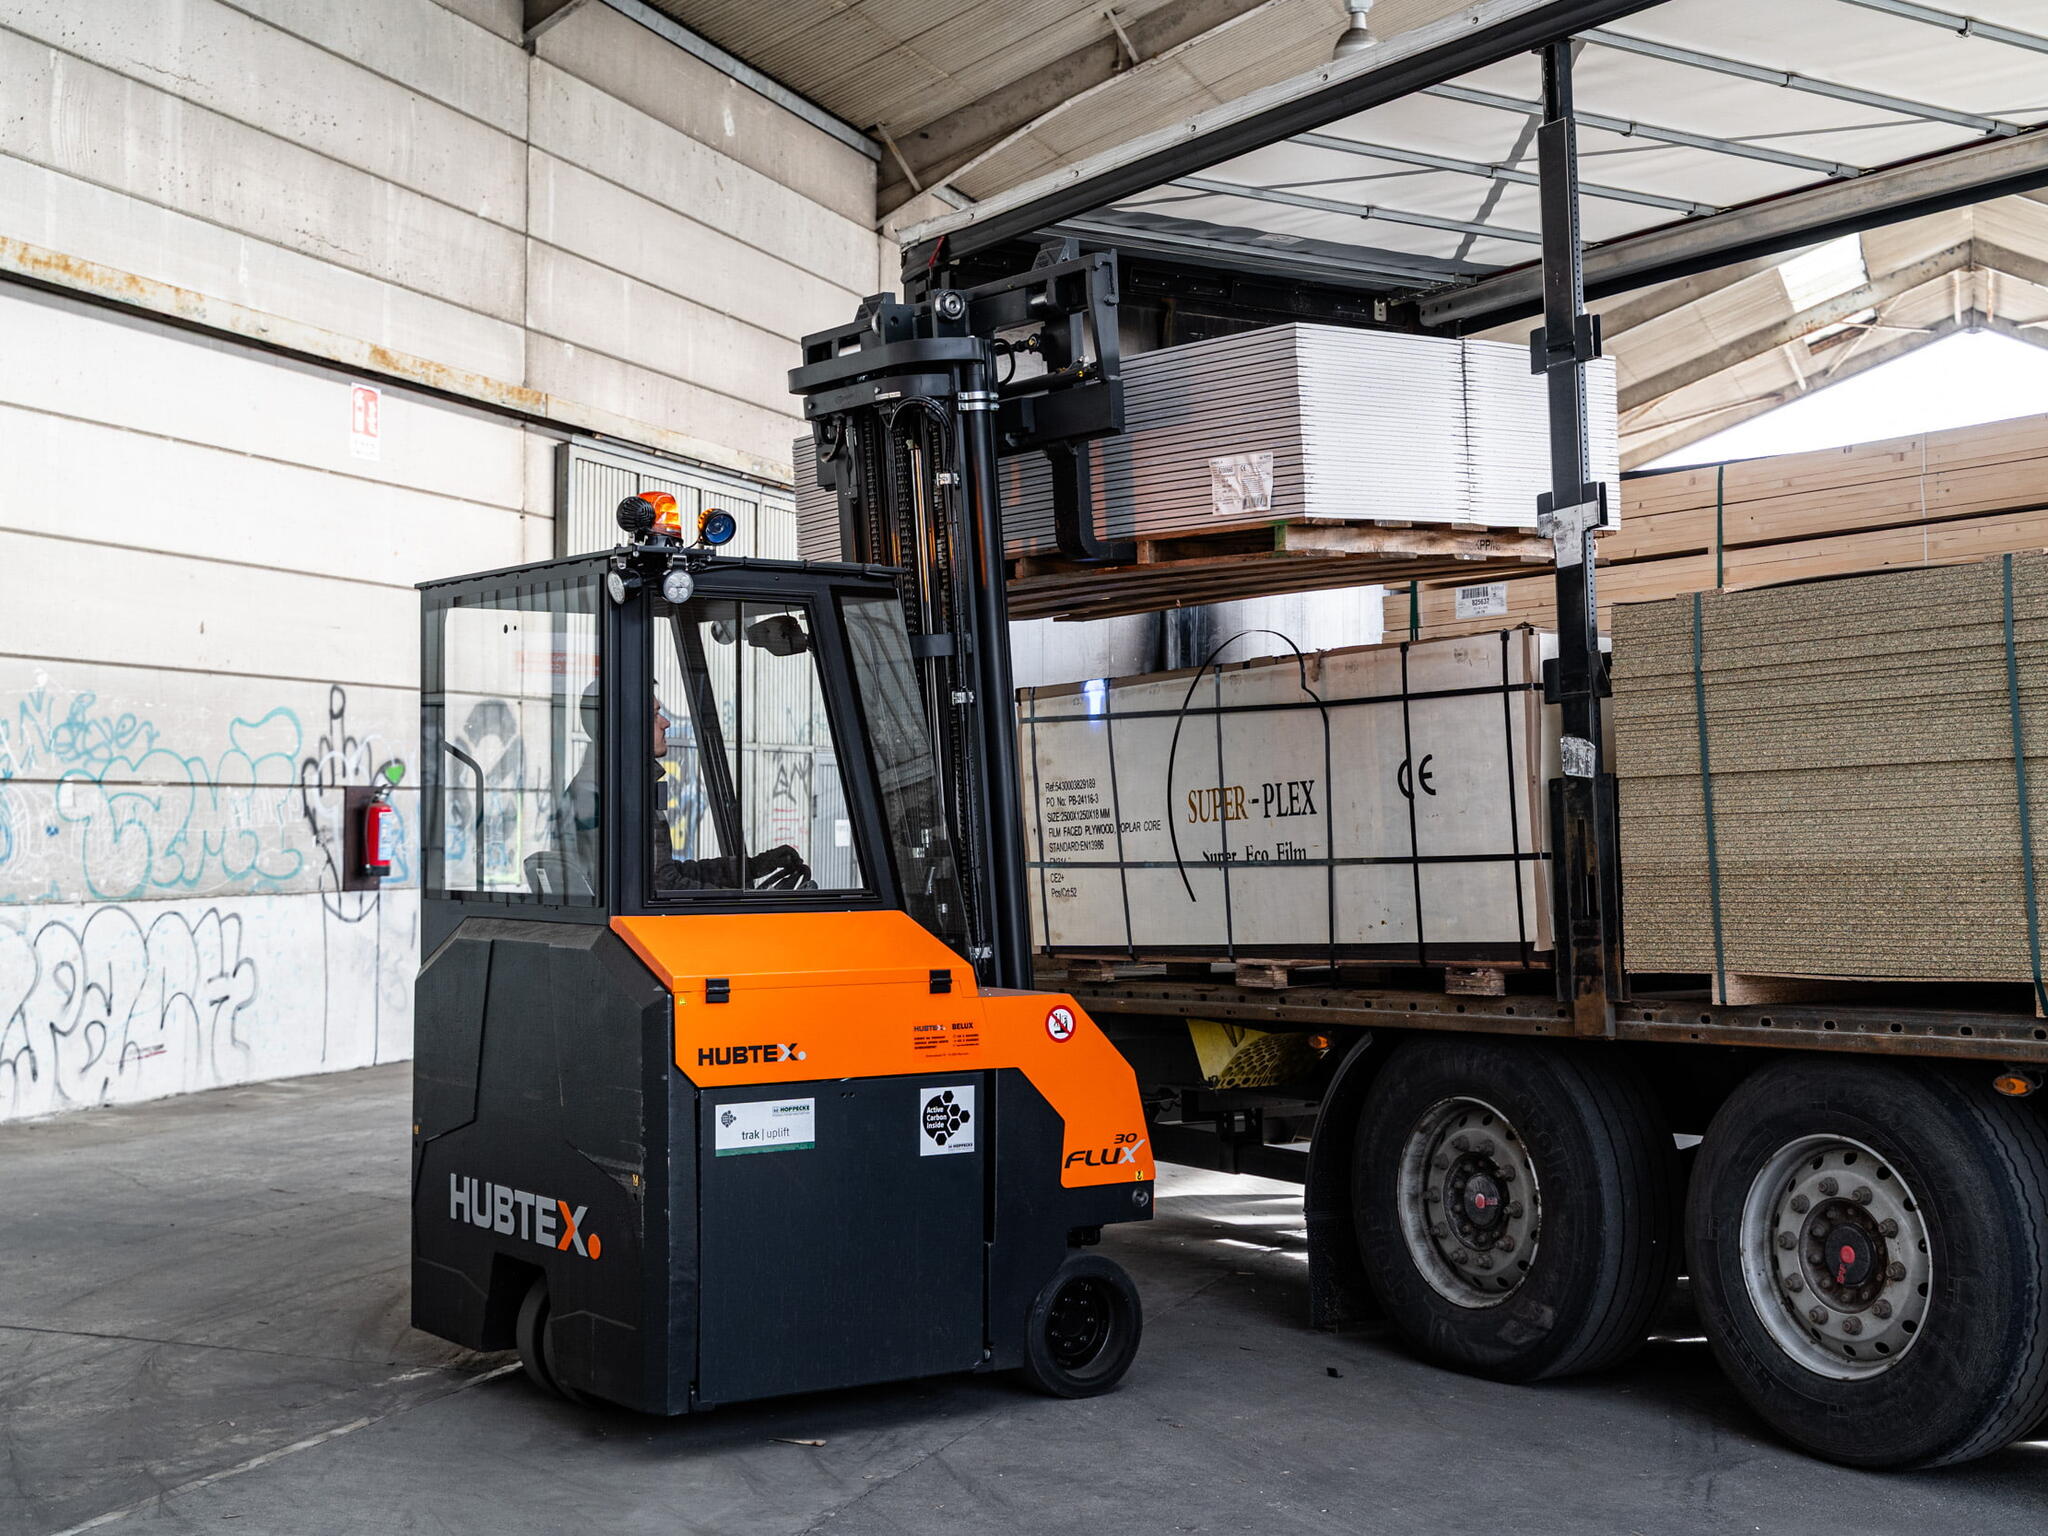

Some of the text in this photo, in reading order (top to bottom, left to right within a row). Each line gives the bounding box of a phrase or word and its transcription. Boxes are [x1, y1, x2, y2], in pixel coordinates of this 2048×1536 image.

[1046, 798, 1055, 807] PO
[1049, 827, 1060, 837] FILM
[1063, 826, 1082, 836] FACED
[1117, 821, 1141, 833] OPLAR
[1144, 820, 1161, 831] CORE
[1245, 845, 1269, 861] Eco
[1276, 842, 1306, 861] Film
[952, 1022, 974, 1030] BELUX
[780, 1104, 810, 1112] HOPPECKE
[927, 1114, 947, 1122] Carbon
[927, 1121, 944, 1129] Inside
[742, 1127, 790, 1140] trak uplift
[1113, 1132, 1138, 1144] 30
[1064, 1139, 1146, 1168] FLUX
